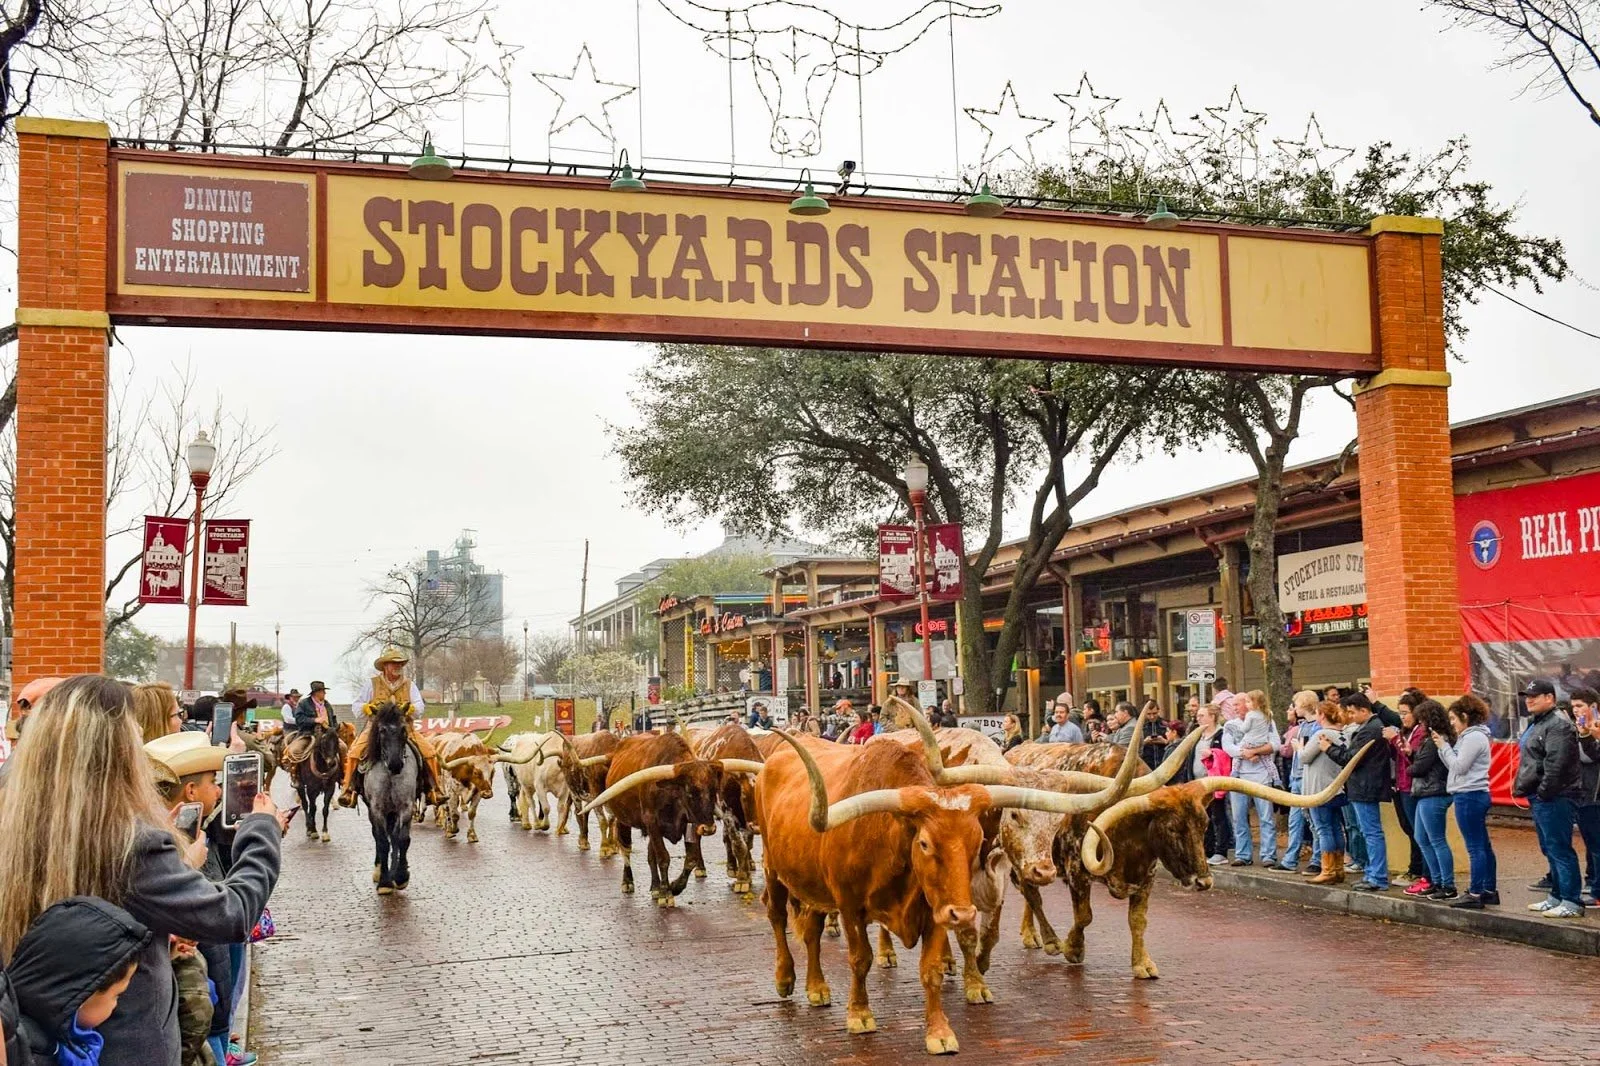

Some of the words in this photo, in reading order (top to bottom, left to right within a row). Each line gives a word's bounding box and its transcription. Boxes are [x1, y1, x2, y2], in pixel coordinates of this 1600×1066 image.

[184, 187, 253, 214] DINING
[171, 219, 265, 246] SHOPPING
[135, 248, 301, 280] ENTERTAINMENT
[362, 196, 874, 309] STOCKYARDS
[903, 228, 1191, 328] STATION
[1520, 511, 1573, 560] REAL
[1283, 554, 1341, 596] STOCKYARDS
[1298, 589, 1318, 601] RETAIL
[1320, 589, 1325, 599] &
[1310, 619, 1354, 634] TRADING
[413, 716, 502, 730] SWIFT
[961, 719, 1003, 729] CBOY
